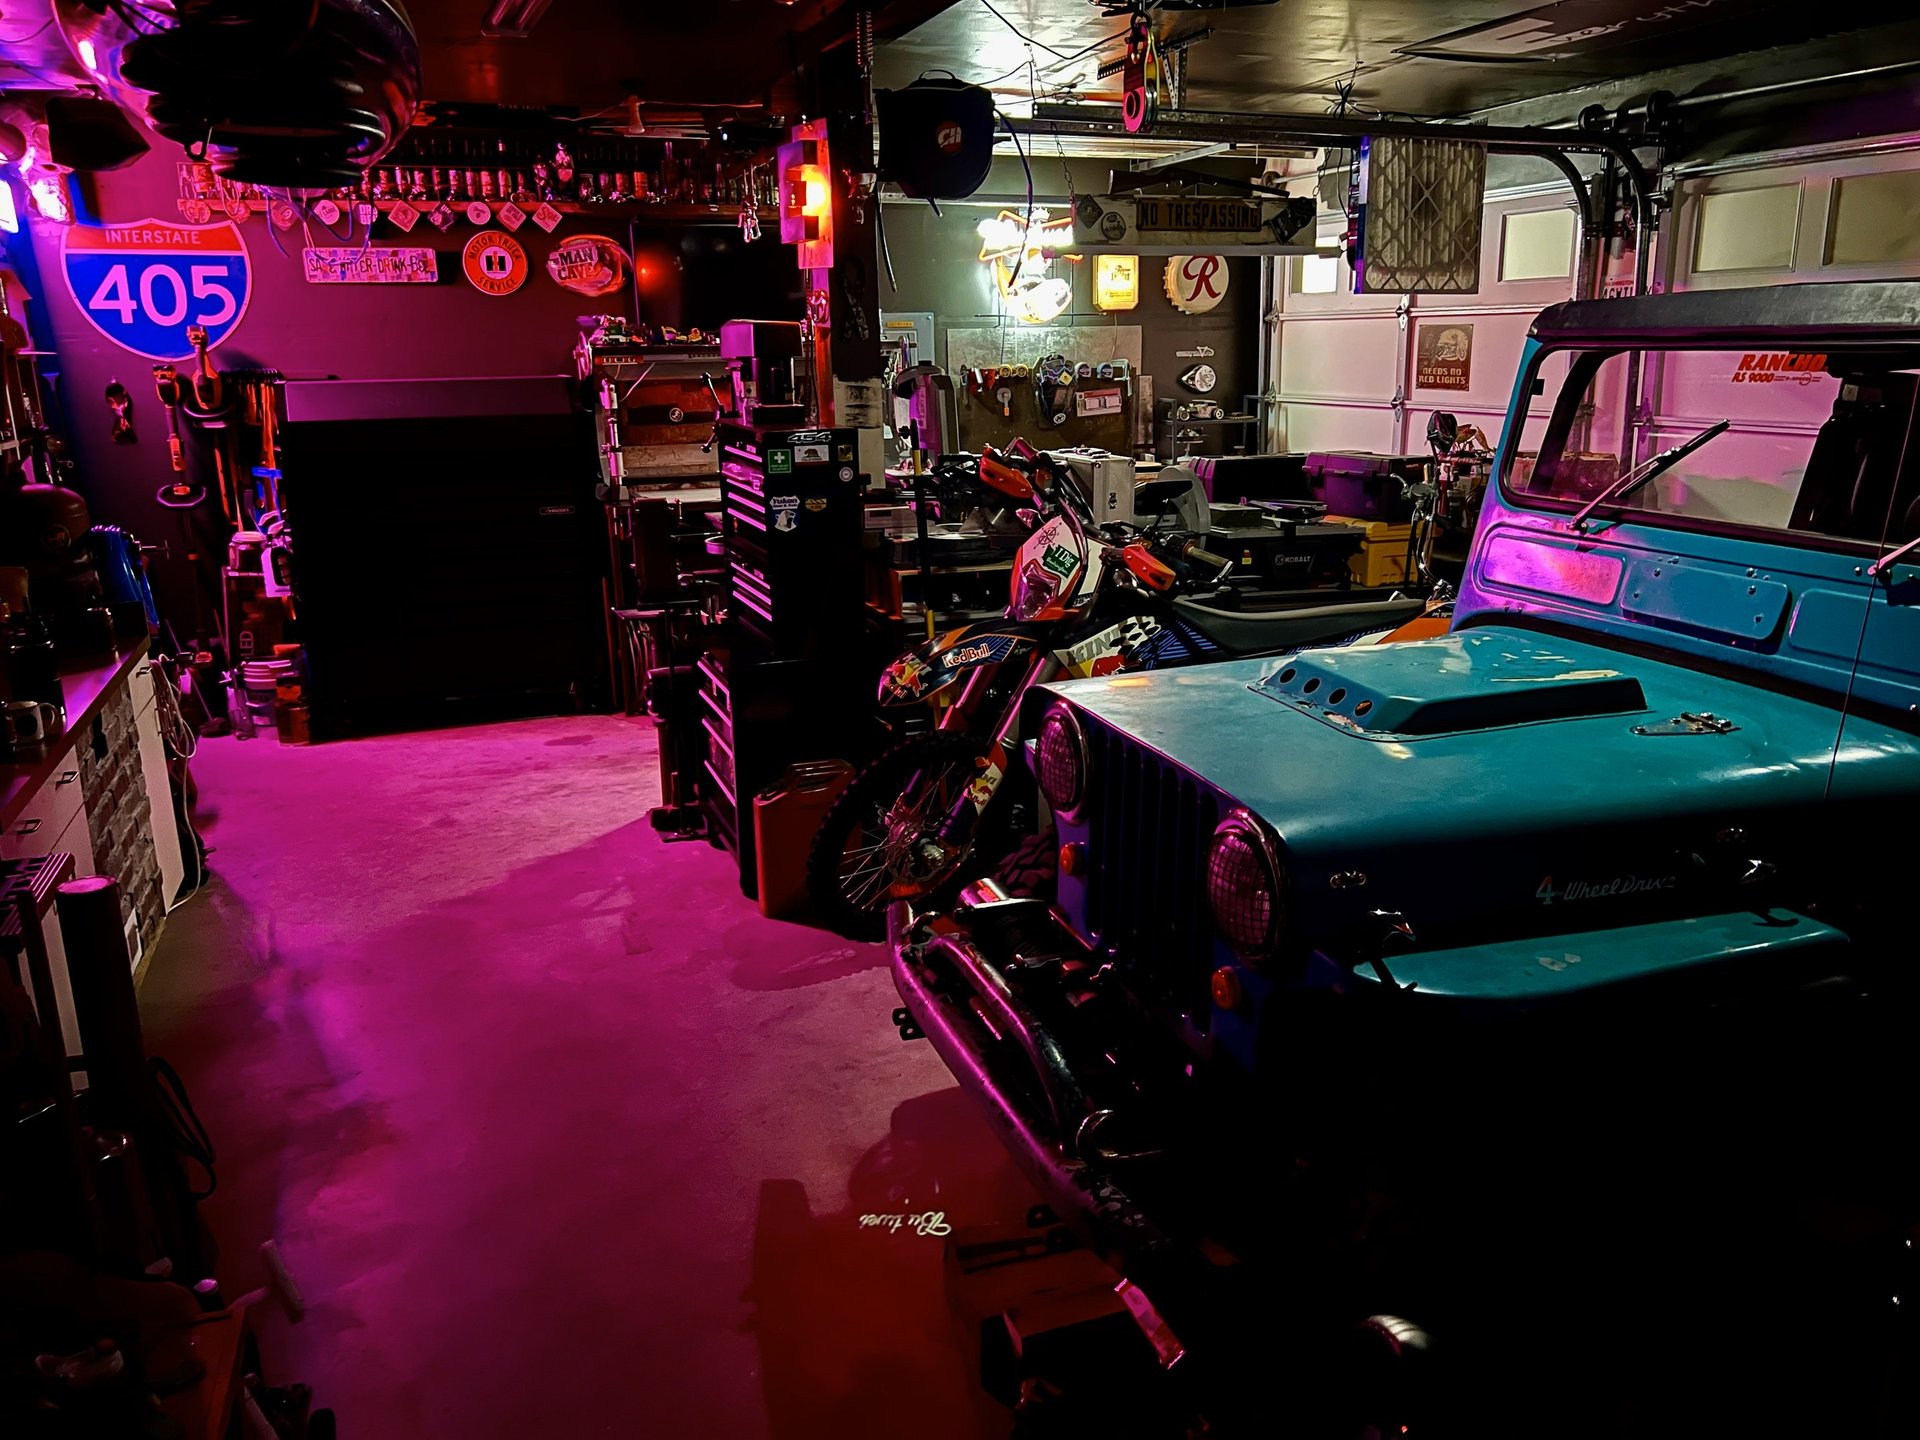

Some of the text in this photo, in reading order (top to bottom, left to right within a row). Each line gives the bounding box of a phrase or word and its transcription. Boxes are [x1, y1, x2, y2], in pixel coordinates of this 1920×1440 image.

[1140, 202, 1158, 226] NO
[1166, 202, 1260, 228] TRESPASSING
[105, 229, 201, 244] INTERSTATE
[468, 235, 520, 261] MOTOR TRUCK
[557, 248, 595, 267] MAN
[476, 275, 517, 291] SERVICE
[88, 263, 237, 327] 405
[1422, 367, 1463, 376] NEEDS NO
[1737, 354, 1828, 372] RANCHO
[1418, 375, 1466, 384] RED LIGHTS
[786, 430, 833, 444] 454
[1284, 555, 1313, 564] KOBALT
[967, 642, 991, 662] Bull
[1562, 877, 1621, 901] Wheel
